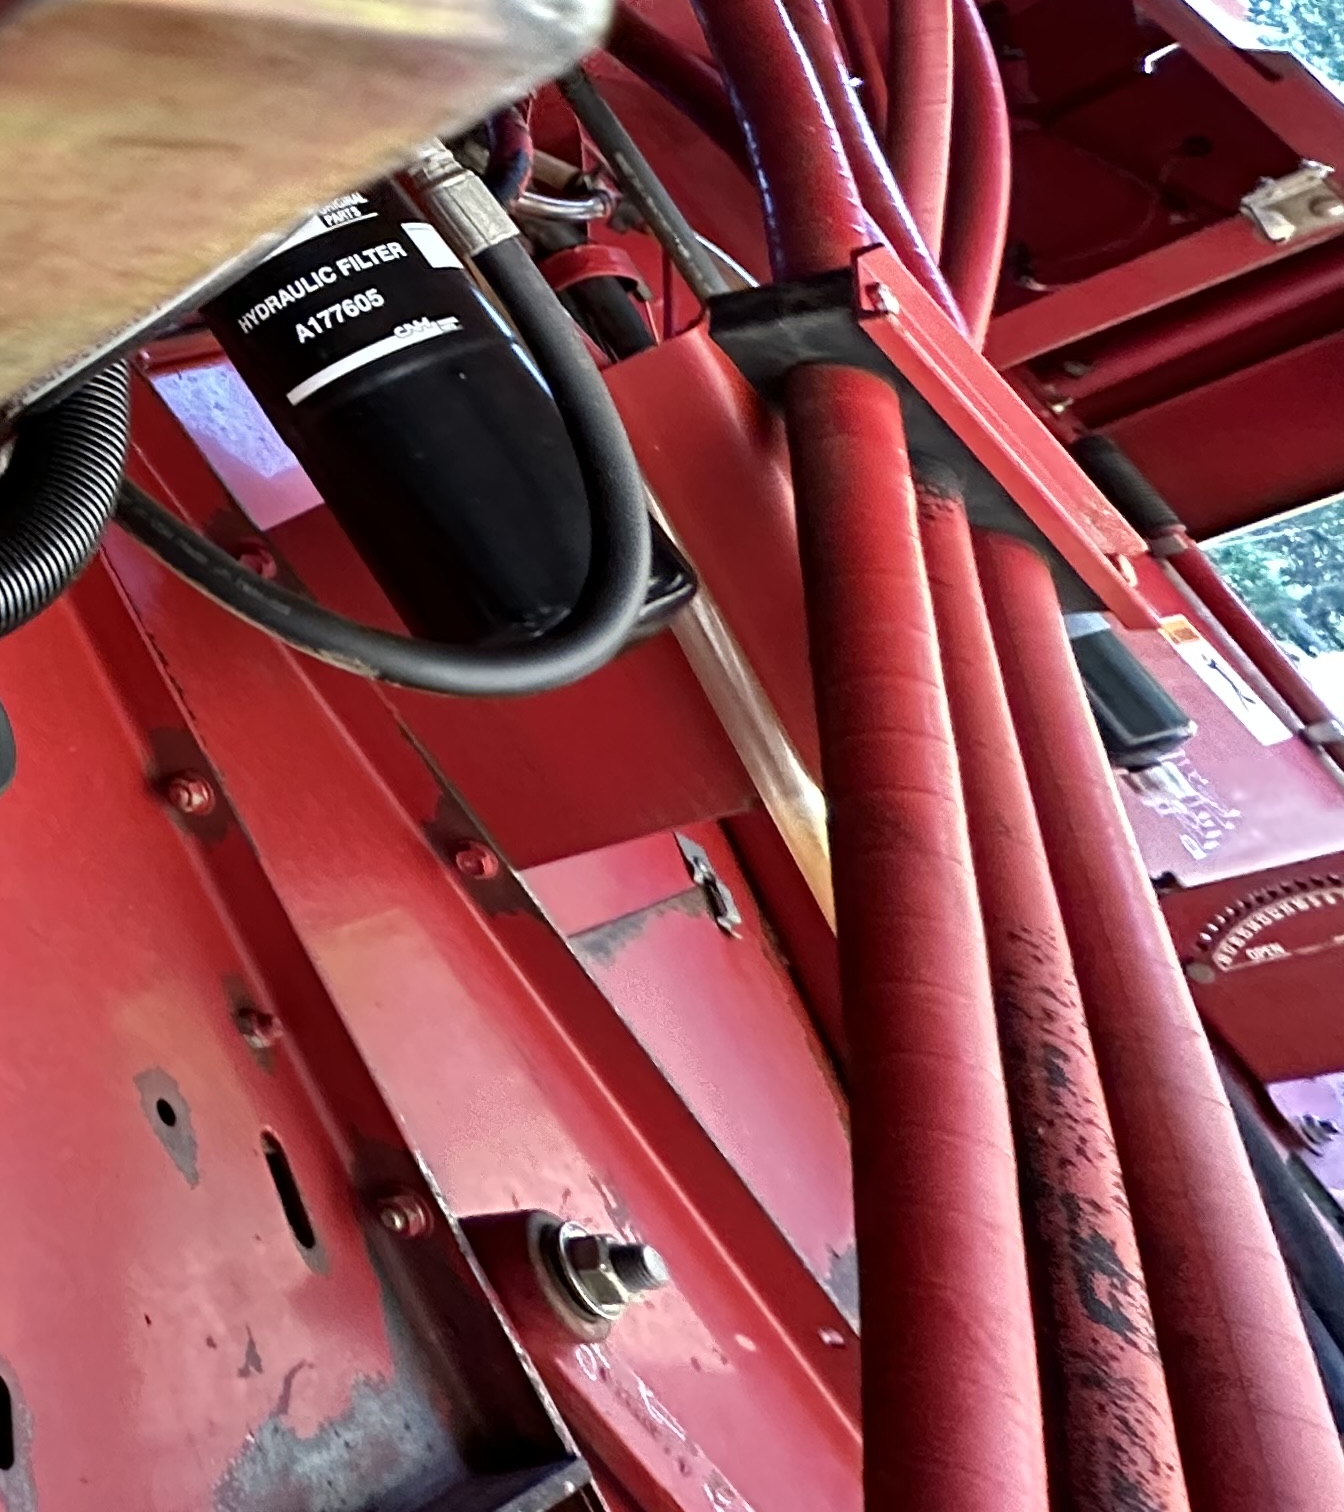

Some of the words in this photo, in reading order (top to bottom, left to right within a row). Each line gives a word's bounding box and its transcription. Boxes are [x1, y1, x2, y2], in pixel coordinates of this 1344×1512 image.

[323, 206, 362, 226] PARTS
[238, 266, 337, 334] HYDRAULIC
[336, 242, 408, 277] FILTER
[294, 288, 385, 344] A177605
